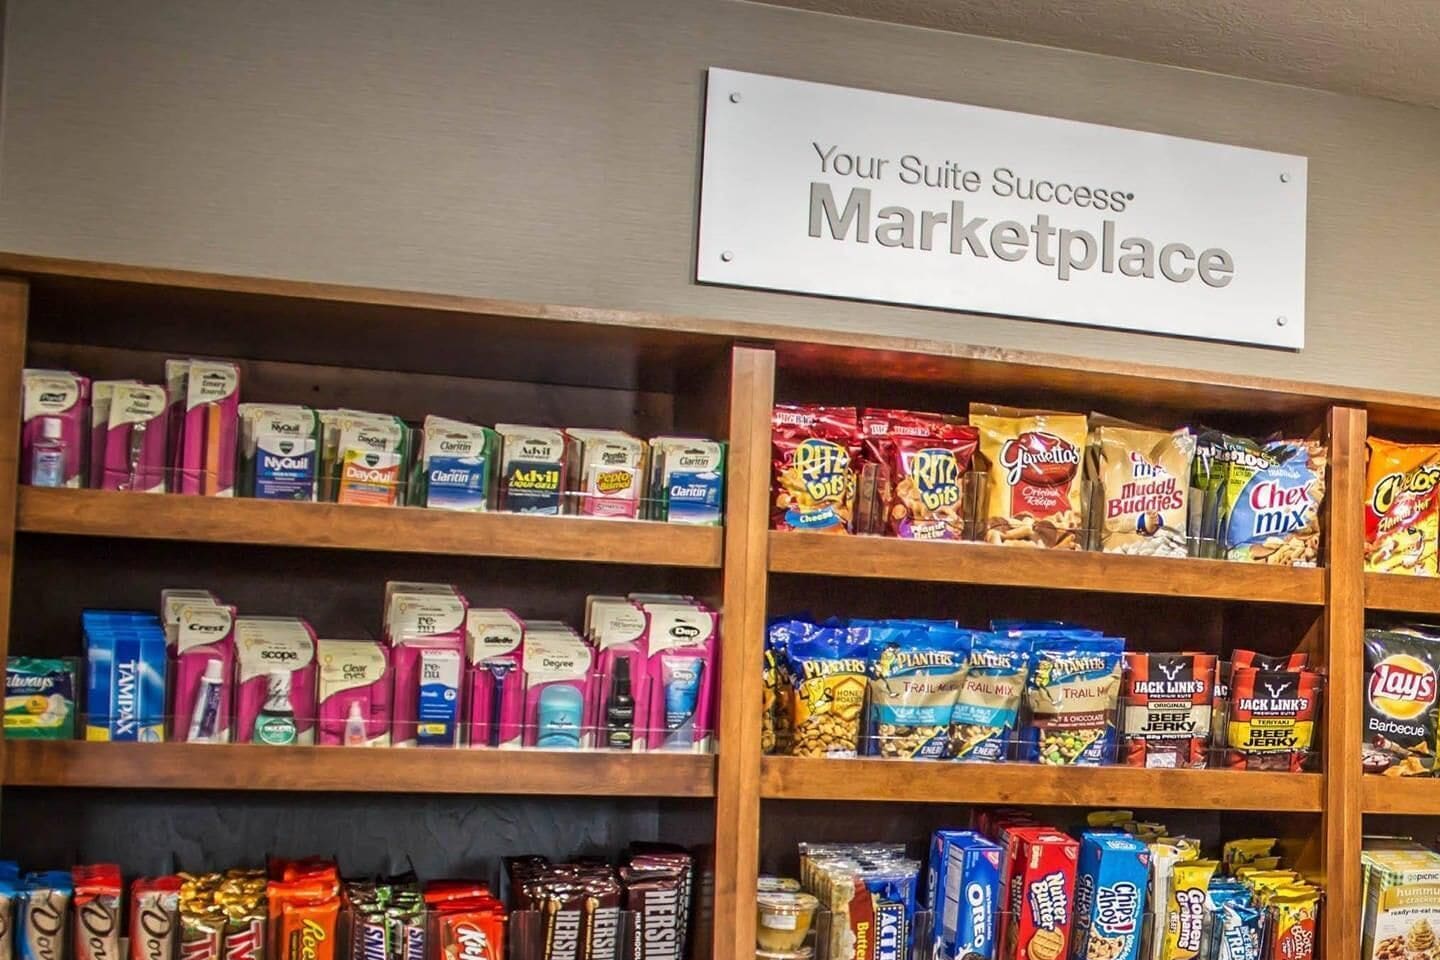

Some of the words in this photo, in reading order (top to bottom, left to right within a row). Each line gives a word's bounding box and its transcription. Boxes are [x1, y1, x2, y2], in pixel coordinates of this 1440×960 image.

[811, 142, 888, 181] Your
[899, 154, 981, 193] Suite
[808, 181, 1235, 289] Marketplace
[271, 422, 300, 433] NyQuil
[357, 434, 387, 446] DayQuil
[440, 441, 472, 451] Claritin
[522, 446, 551, 457] Advil
[796, 440, 849, 476] RITZ
[264, 456, 308, 471] NyQuil
[679, 456, 709, 467] Claritin
[910, 450, 959, 487] RITZ
[431, 472, 468, 484] Claritin
[512, 468, 559, 484] Advil
[670, 485, 707, 498] Claritin
[806, 475, 846, 501] bits
[1120, 478, 1176, 500] Muddy
[1251, 480, 1315, 511] Chex
[920, 484, 960, 511] bits
[1107, 490, 1184, 519] Buddies
[1254, 504, 1309, 537] mix
[188, 624, 225, 633] Crest
[342, 663, 367, 674] Clear
[542, 658, 575, 671] Degree
[804, 658, 866, 679] PLANTERS
[898, 652, 953, 670] PLANTERS
[1134, 680, 1165, 694] JACK
[1167, 678, 1204, 694] LINK'S
[1373, 663, 1434, 700] Lay's
[115, 659, 139, 735] TAMPAX
[995, 685, 1014, 696] MIX
[1063, 686, 1093, 699] TRAIL
[1239, 699, 1270, 713] JACK
[1271, 697, 1308, 713] LINK'S
[1070, 713, 1104, 723] CHOCOLATE
[1147, 712, 1190, 723] BEEF
[1257, 719, 1291, 727] TERIYAKI
[1141, 720, 1196, 733] JERKY
[1250, 728, 1294, 740] BEEF
[1369, 718, 1426, 737] Barbecue
[1248, 735, 1298, 748] JERKY
[1031, 880, 1055, 931] Butter
[1045, 872, 1068, 925] Nutter
[1114, 883, 1137, 925] Chips
[967, 883, 988, 949] OREO
[1175, 892, 1191, 949] Grahams
[1187, 889, 1204, 951] Golden
[1391, 908, 1431, 916] ready-to-eat
[879, 912, 899, 949] ACT
[1290, 925, 1306, 960] Batch
